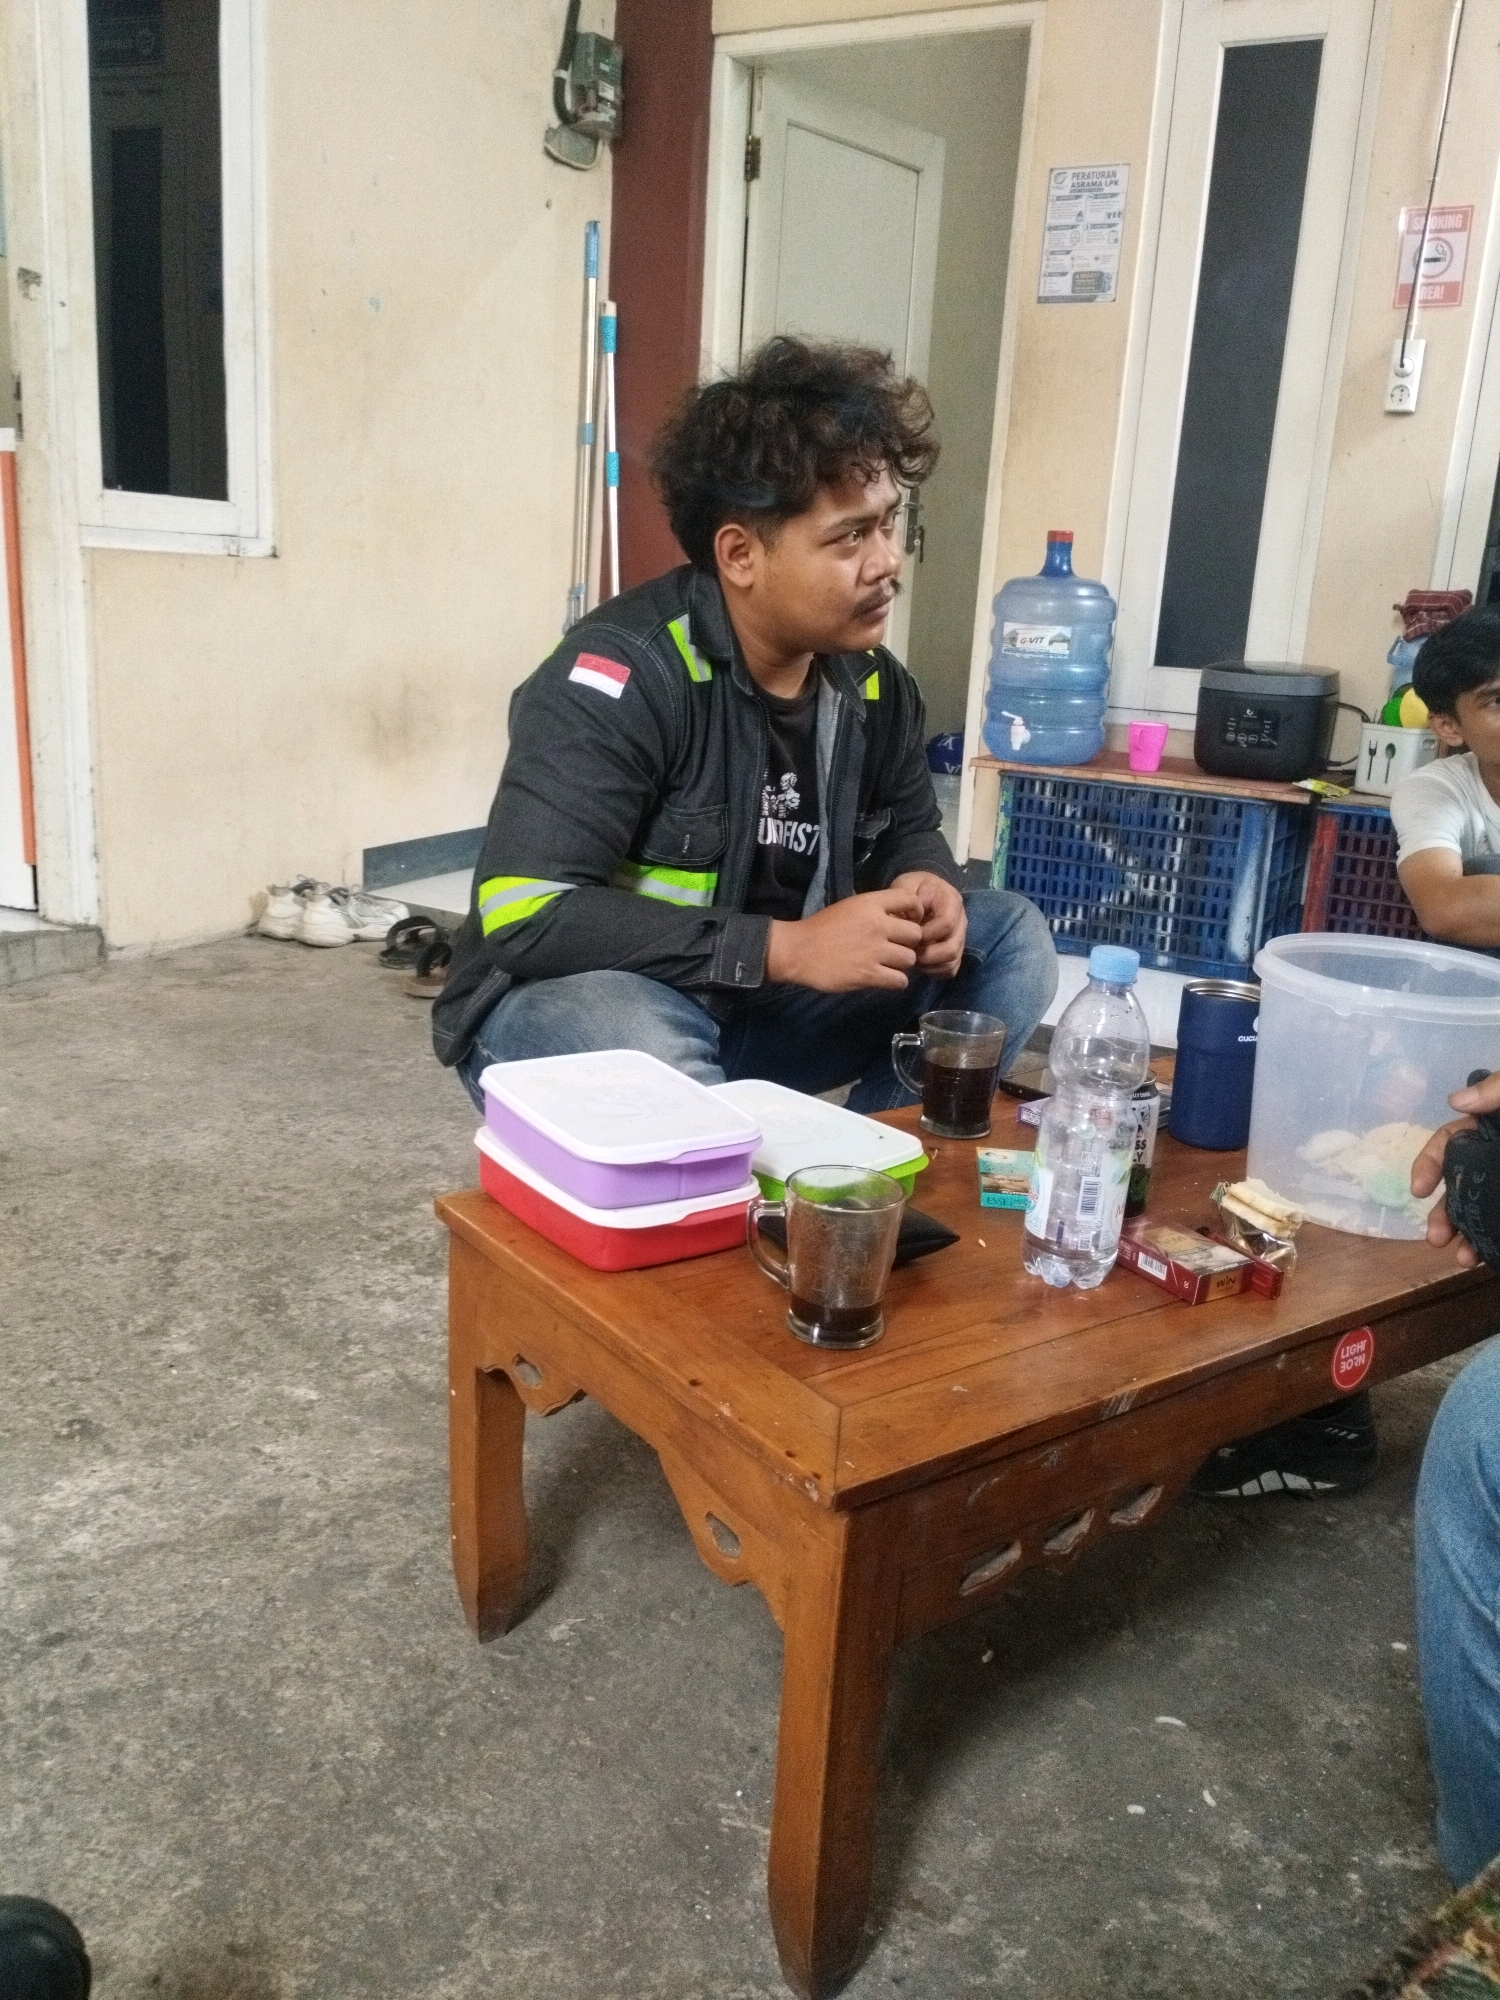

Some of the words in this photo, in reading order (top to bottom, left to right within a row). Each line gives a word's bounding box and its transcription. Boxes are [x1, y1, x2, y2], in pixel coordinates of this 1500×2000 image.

[1071, 170, 1117, 180] PERATURAN
[1071, 180, 1103, 189] ASRAMA
[1104, 179, 1119, 187] LPK
[1416, 285, 1445, 300] REA!
[1340, 1339, 1367, 1360] LIGHT
